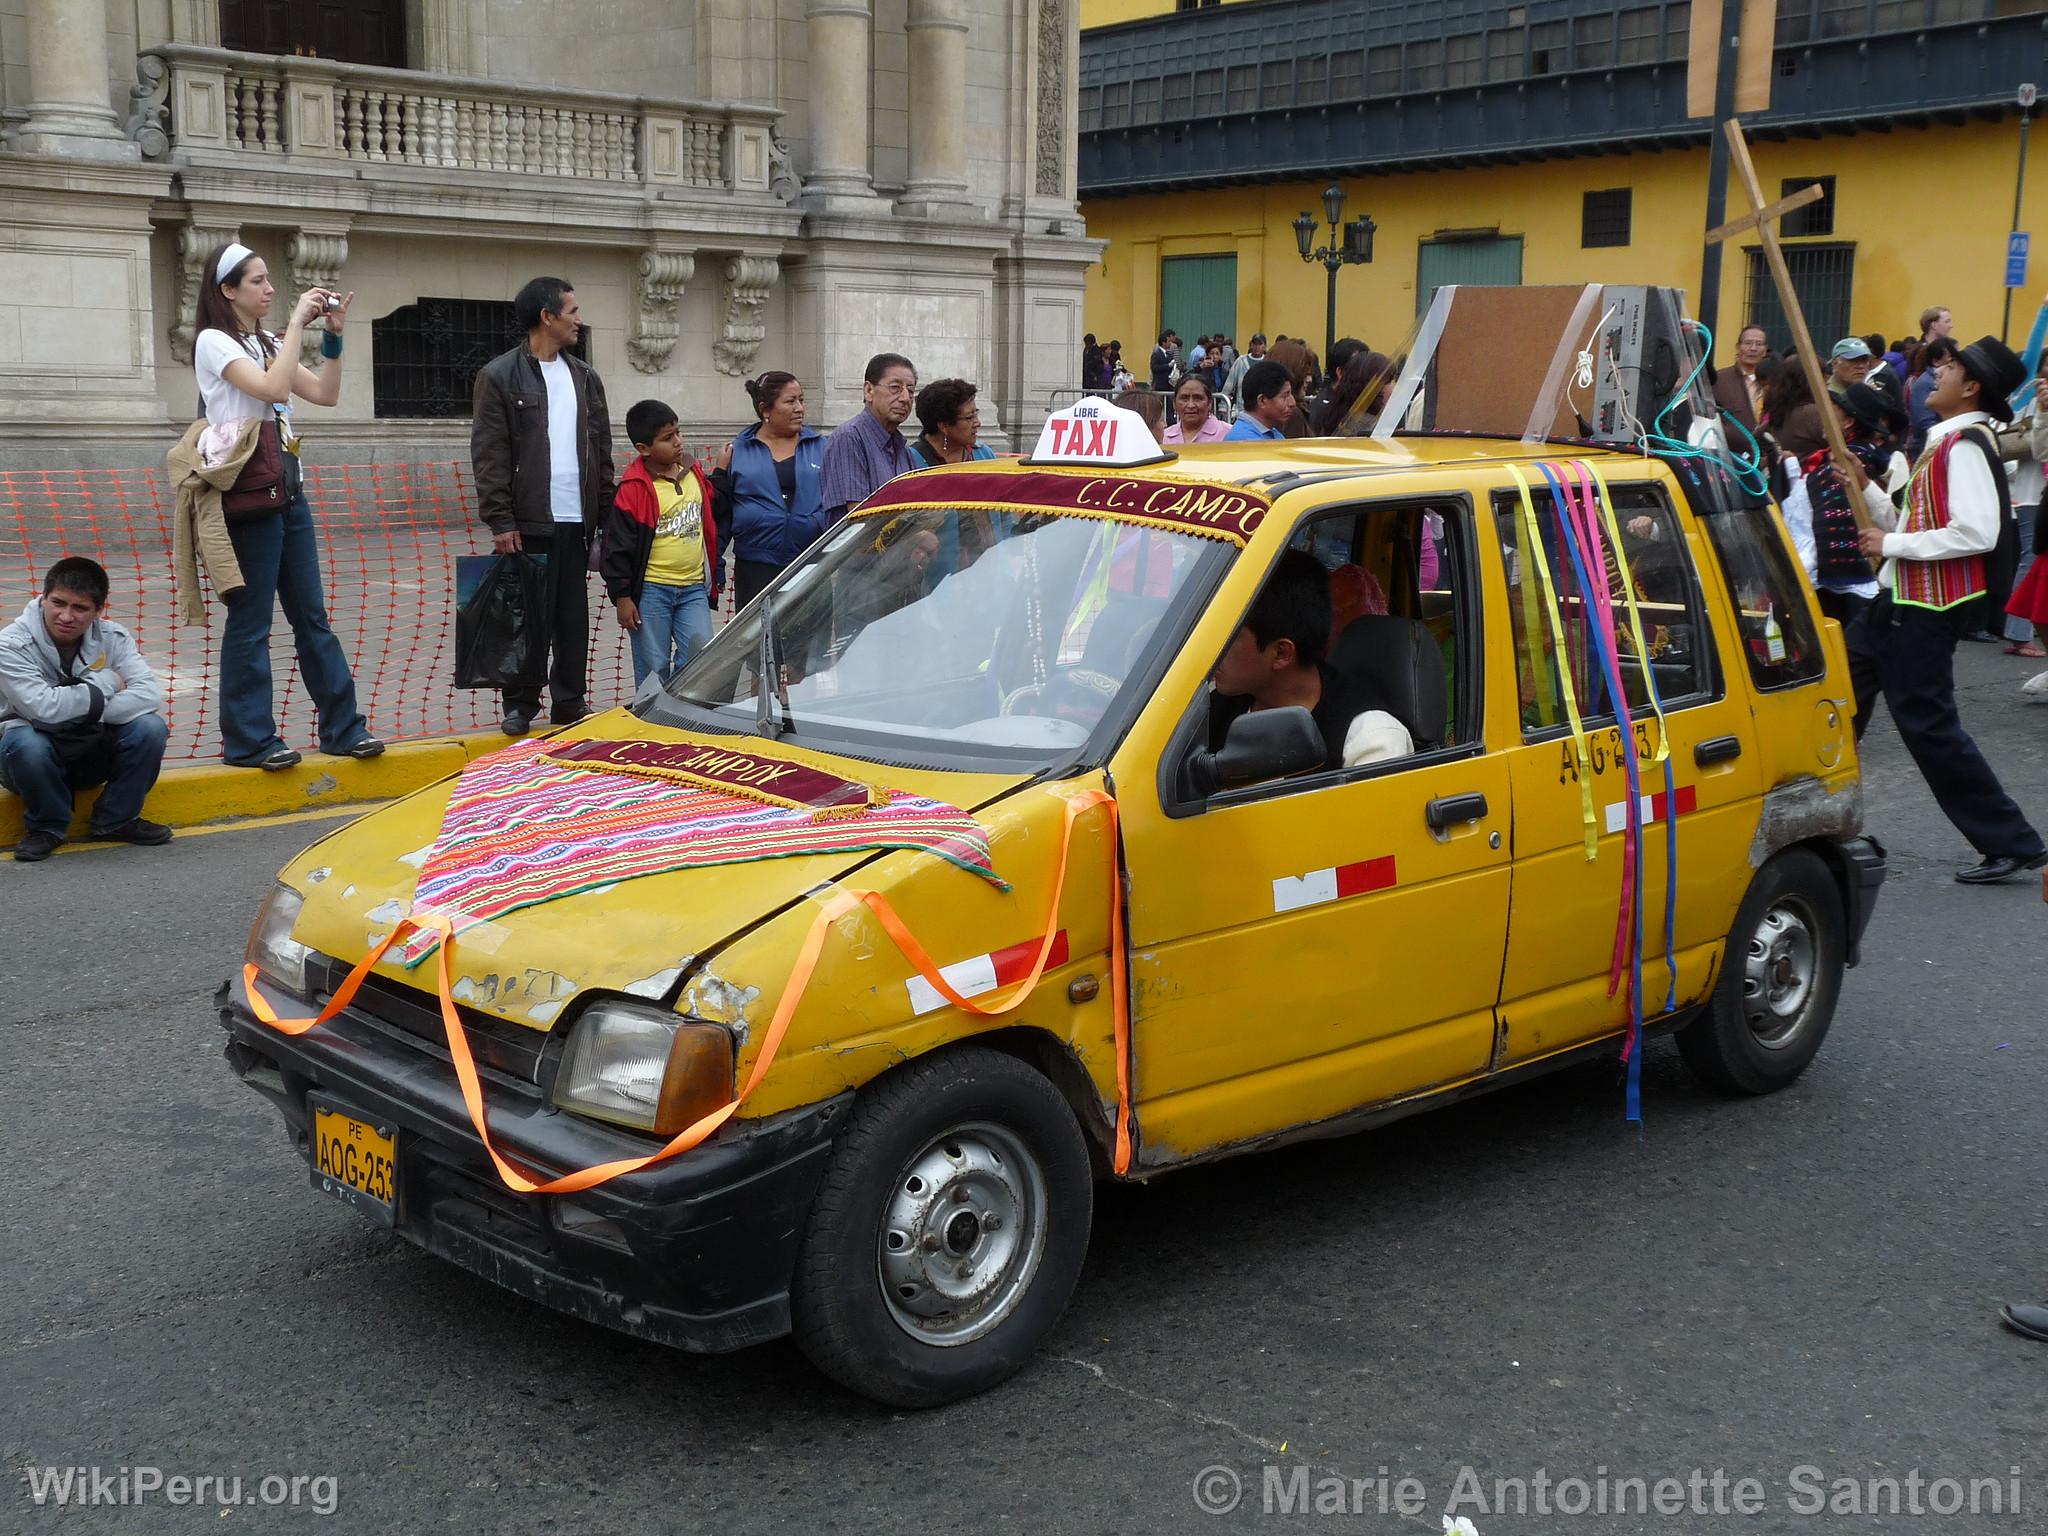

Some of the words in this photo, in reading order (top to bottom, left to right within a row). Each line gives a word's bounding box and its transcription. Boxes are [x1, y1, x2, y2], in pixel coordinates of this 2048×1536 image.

[1073, 407, 1099, 418] LIBRE
[1050, 419, 1118, 457] TAXI
[1143, 486, 1266, 535] CAMPO
[1560, 722, 1653, 786] AG-23
[348, 1122, 363, 1141] PE
[320, 1132, 394, 1203] AOG-253
